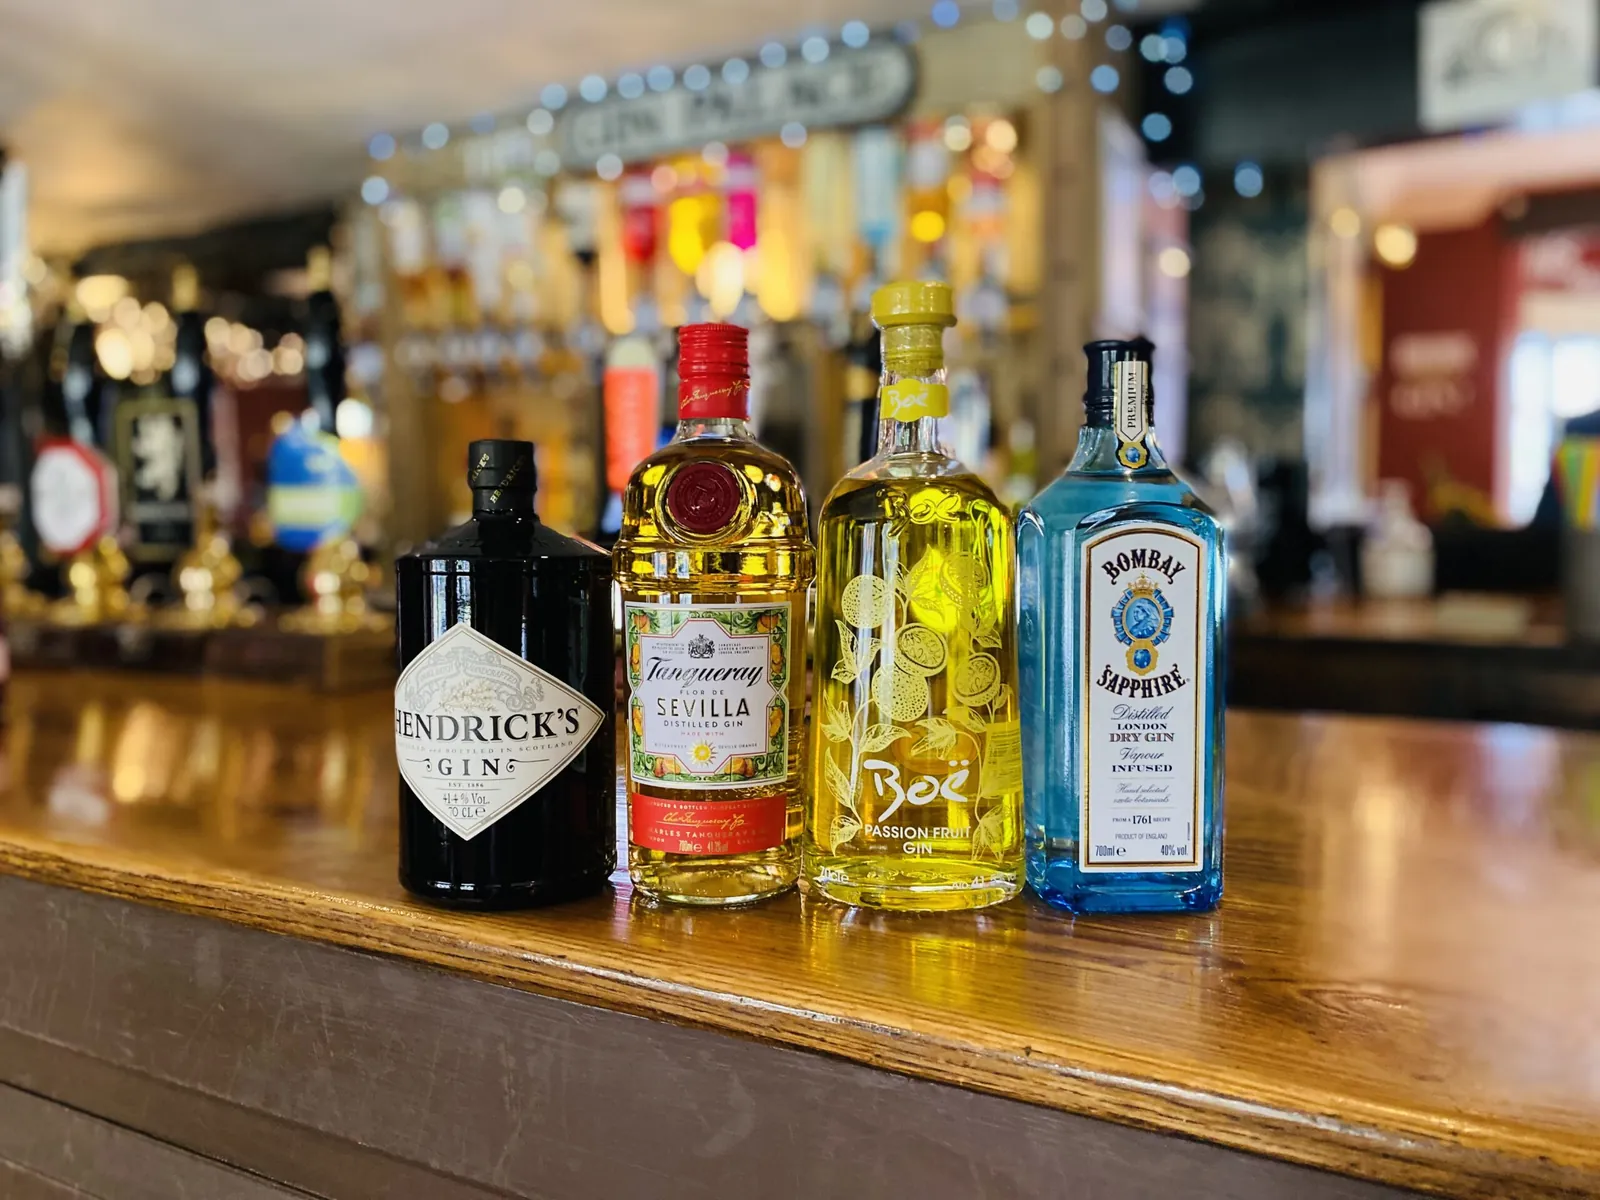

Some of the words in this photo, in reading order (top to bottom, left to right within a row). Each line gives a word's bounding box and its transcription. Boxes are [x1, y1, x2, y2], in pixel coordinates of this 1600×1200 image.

[1127, 372, 1137, 428] PREMIUM
[1101, 548, 1186, 585] BOMBAY
[646, 656, 764, 688] Tanqueray
[1096, 663, 1186, 698] SAPPHIRE
[657, 697, 750, 717] SEVILLA
[1110, 703, 1174, 720] Distilled
[1109, 732, 1142, 742] DRY
[1144, 732, 1175, 742] GIN
[519, 741, 573, 752] SCOTLAND
[1119, 747, 1165, 763] Vapour
[438, 758, 500, 776] GIN
[1112, 764, 1173, 772] INFUSED
[863, 758, 970, 823] Boë
[1132, 815, 1152, 824] 1761
[864, 824, 929, 839] PASSION
[933, 825, 971, 839] FRUIT
[903, 842, 932, 854] GIN
[1095, 845, 1115, 856] 700ml
[1160, 844, 1176, 856] 40%
